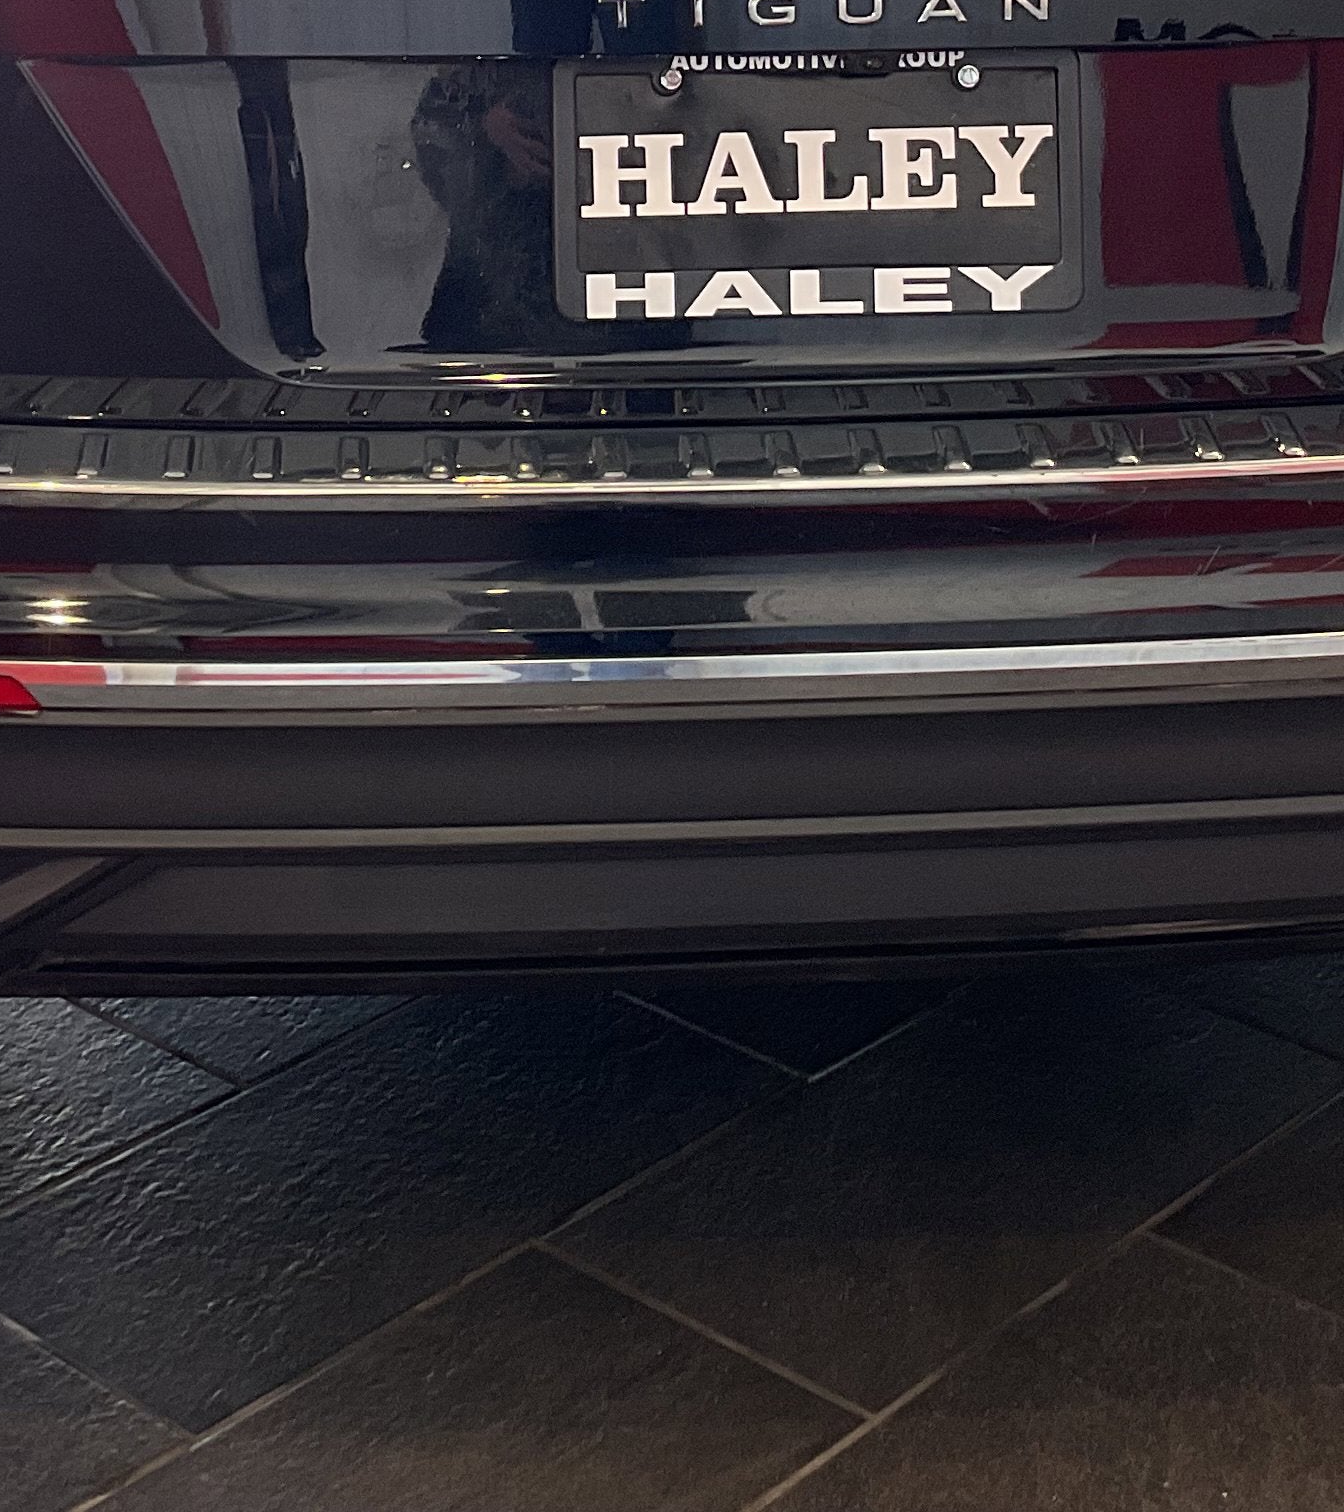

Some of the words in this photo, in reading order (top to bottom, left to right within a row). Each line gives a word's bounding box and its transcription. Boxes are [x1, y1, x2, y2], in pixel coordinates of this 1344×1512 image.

[670, 54, 845, 71] AUTOMOTIV
[579, 124, 1054, 219] HALEY
[586, 265, 1054, 319] HALEY
